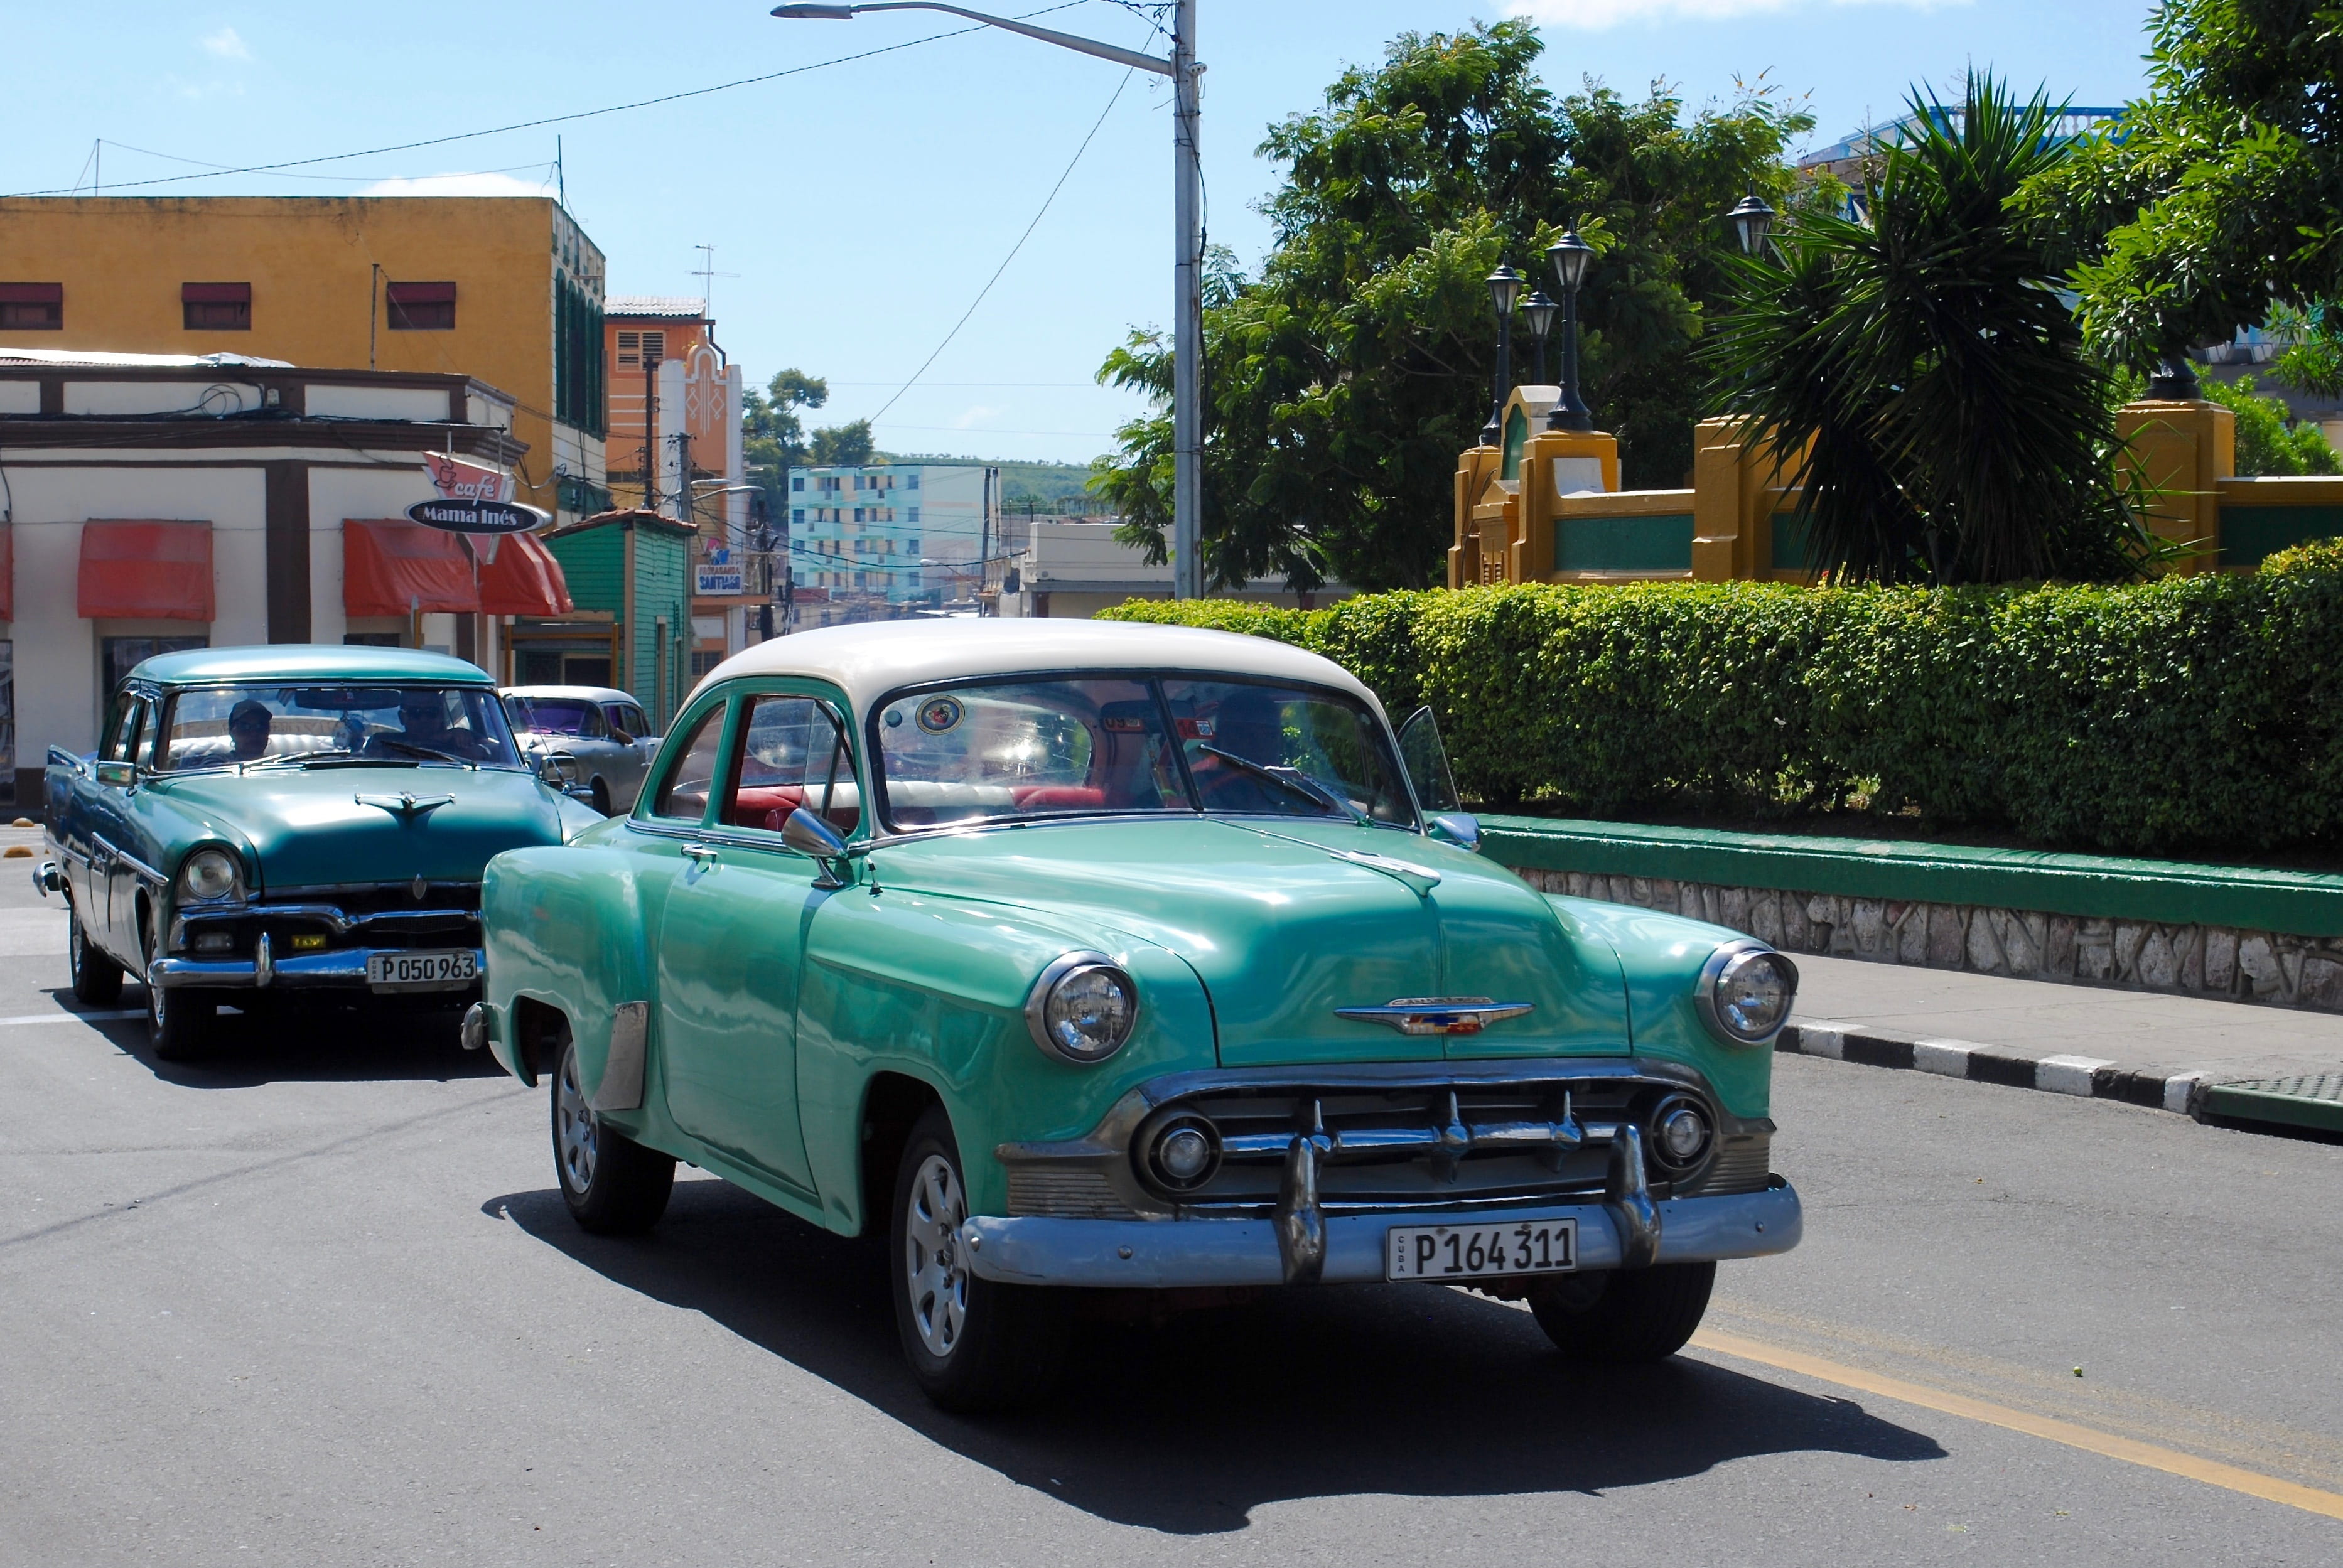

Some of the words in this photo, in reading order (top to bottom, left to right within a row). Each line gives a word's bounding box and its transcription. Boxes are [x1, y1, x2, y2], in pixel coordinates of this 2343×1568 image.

[454, 476, 495, 506] café
[422, 507, 477, 524] Mama
[482, 509, 517, 526] Inés
